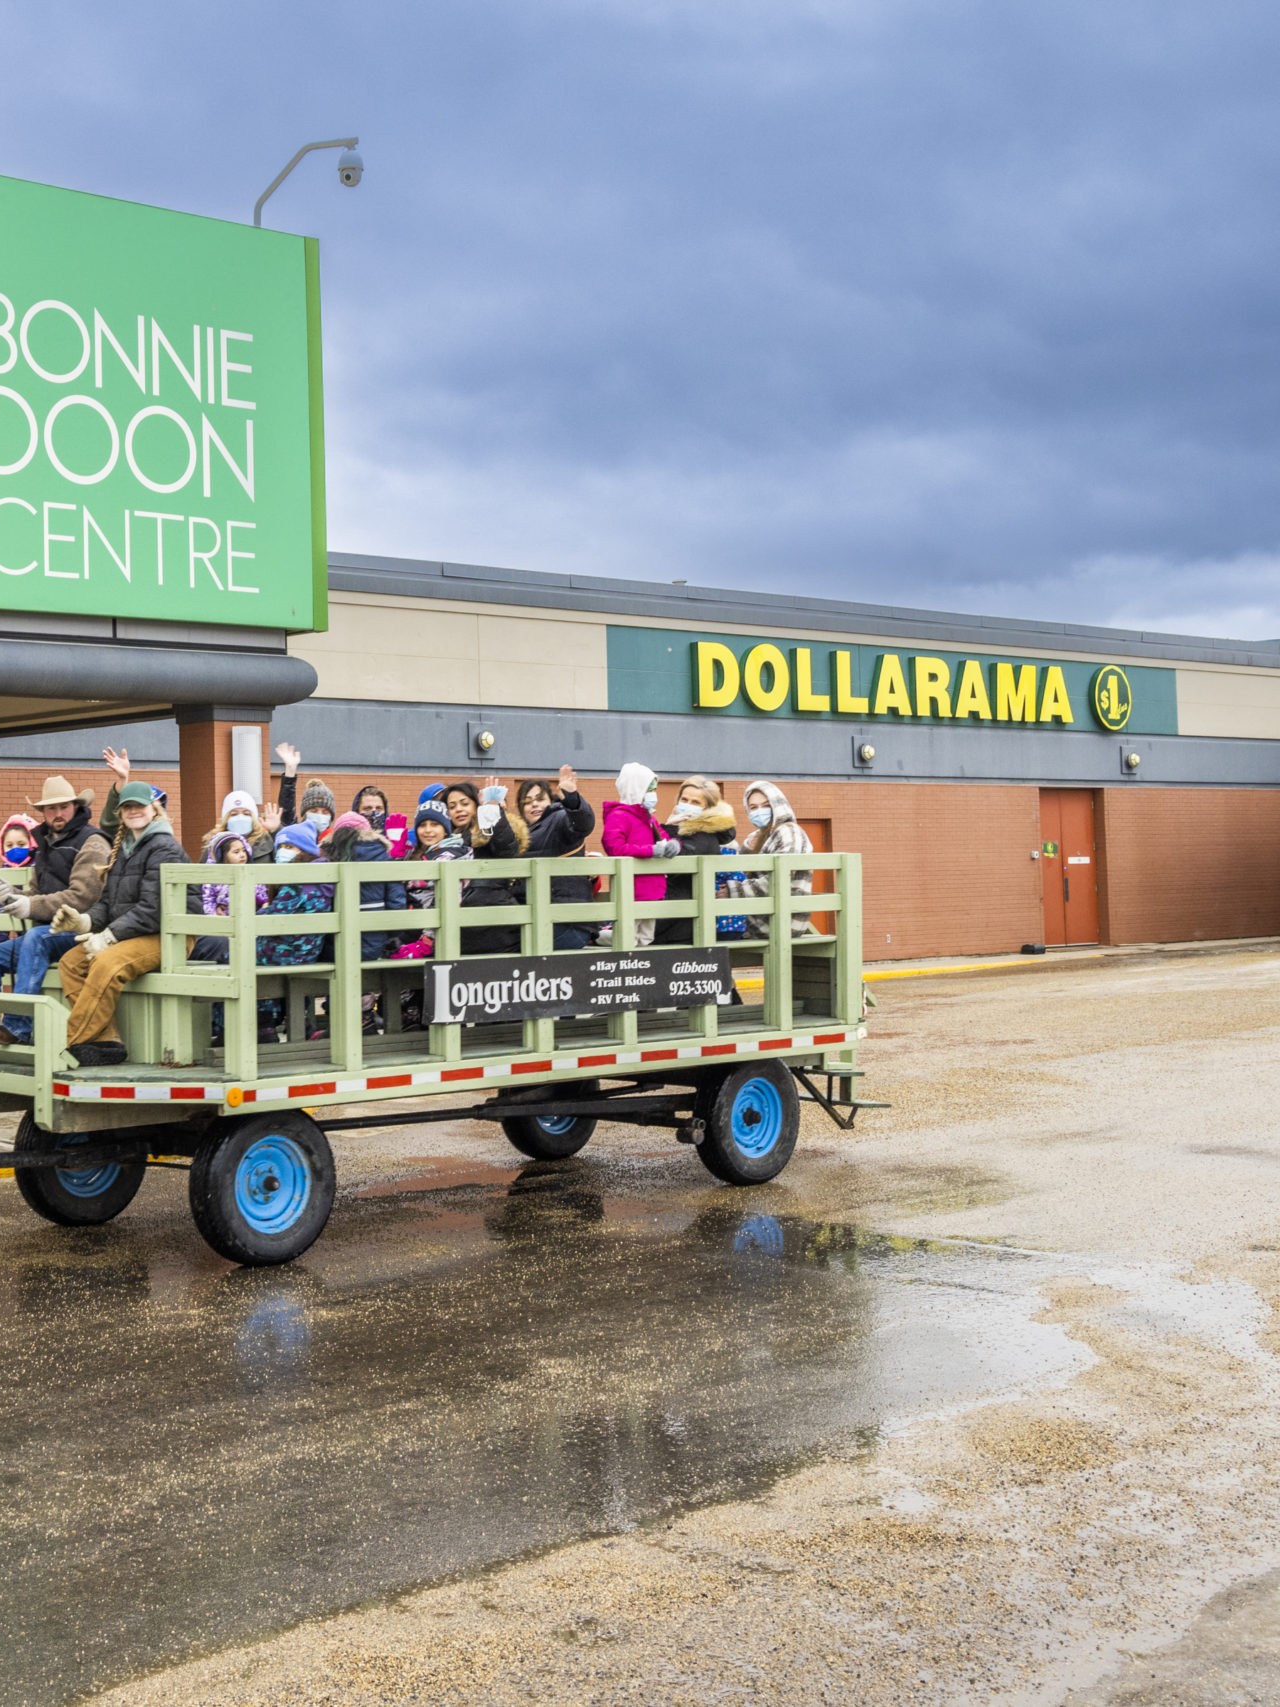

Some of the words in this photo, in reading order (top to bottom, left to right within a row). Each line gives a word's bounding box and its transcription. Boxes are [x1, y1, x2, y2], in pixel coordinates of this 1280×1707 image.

[696, 640, 1075, 724] DOLLARAMA
[596, 961, 617, 973] Hay
[619, 958, 651, 970] Rides
[671, 961, 719, 974] Gibbons
[596, 977, 622, 988] Trail
[624, 975, 657, 987] Rides
[668, 979, 723, 996] 923-3300
[431, 964, 573, 1025] Longriders
[597, 994, 613, 1005] RV
[615, 992, 641, 1004] Park
